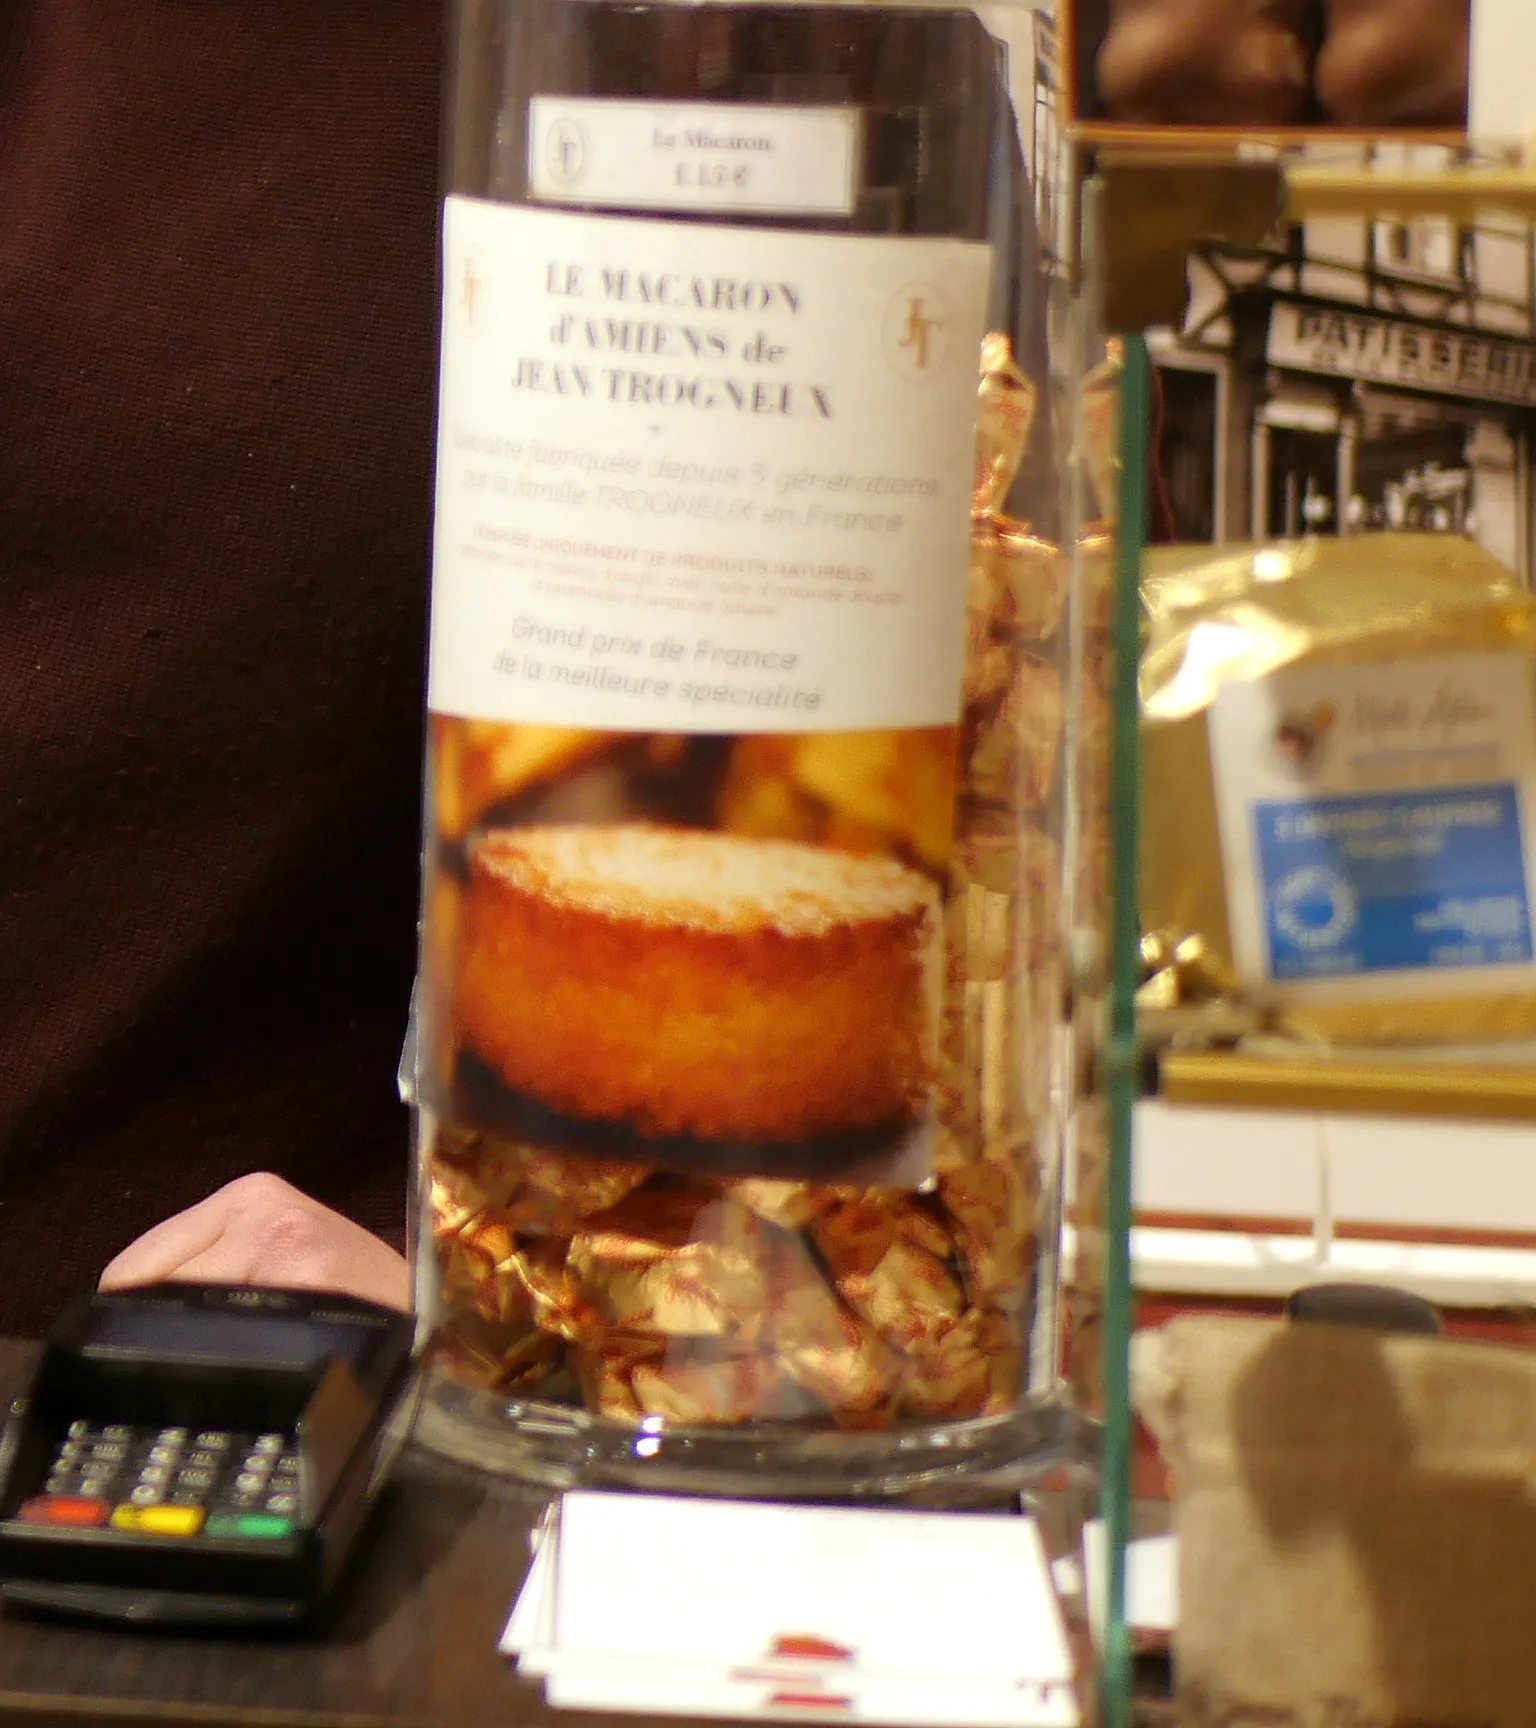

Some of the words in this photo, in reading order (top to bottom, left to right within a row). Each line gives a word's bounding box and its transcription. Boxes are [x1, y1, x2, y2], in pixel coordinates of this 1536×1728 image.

[653, 128, 679, 150] Le
[685, 130, 771, 153] Macaron
[546, 260, 584, 297] LE
[600, 266, 804, 316] MACARON
[550, 313, 728, 359] d'AMIENS
[741, 329, 789, 365] de
[510, 356, 591, 402] JEAN
[603, 367, 833, 419] TROGNEUX
[648, 454, 740, 486] depuis
[748, 461, 767, 486] 5
[594, 483, 756, 523] TROGNEUX
[761, 505, 796, 525] en
[804, 502, 905, 533] France
[512, 614, 586, 650] Grand
[589, 631, 643, 658] prix
[649, 635, 686, 661] de
[693, 637, 799, 672] France
[522, 653, 542, 679] la
[548, 663, 671, 699] meilleure
